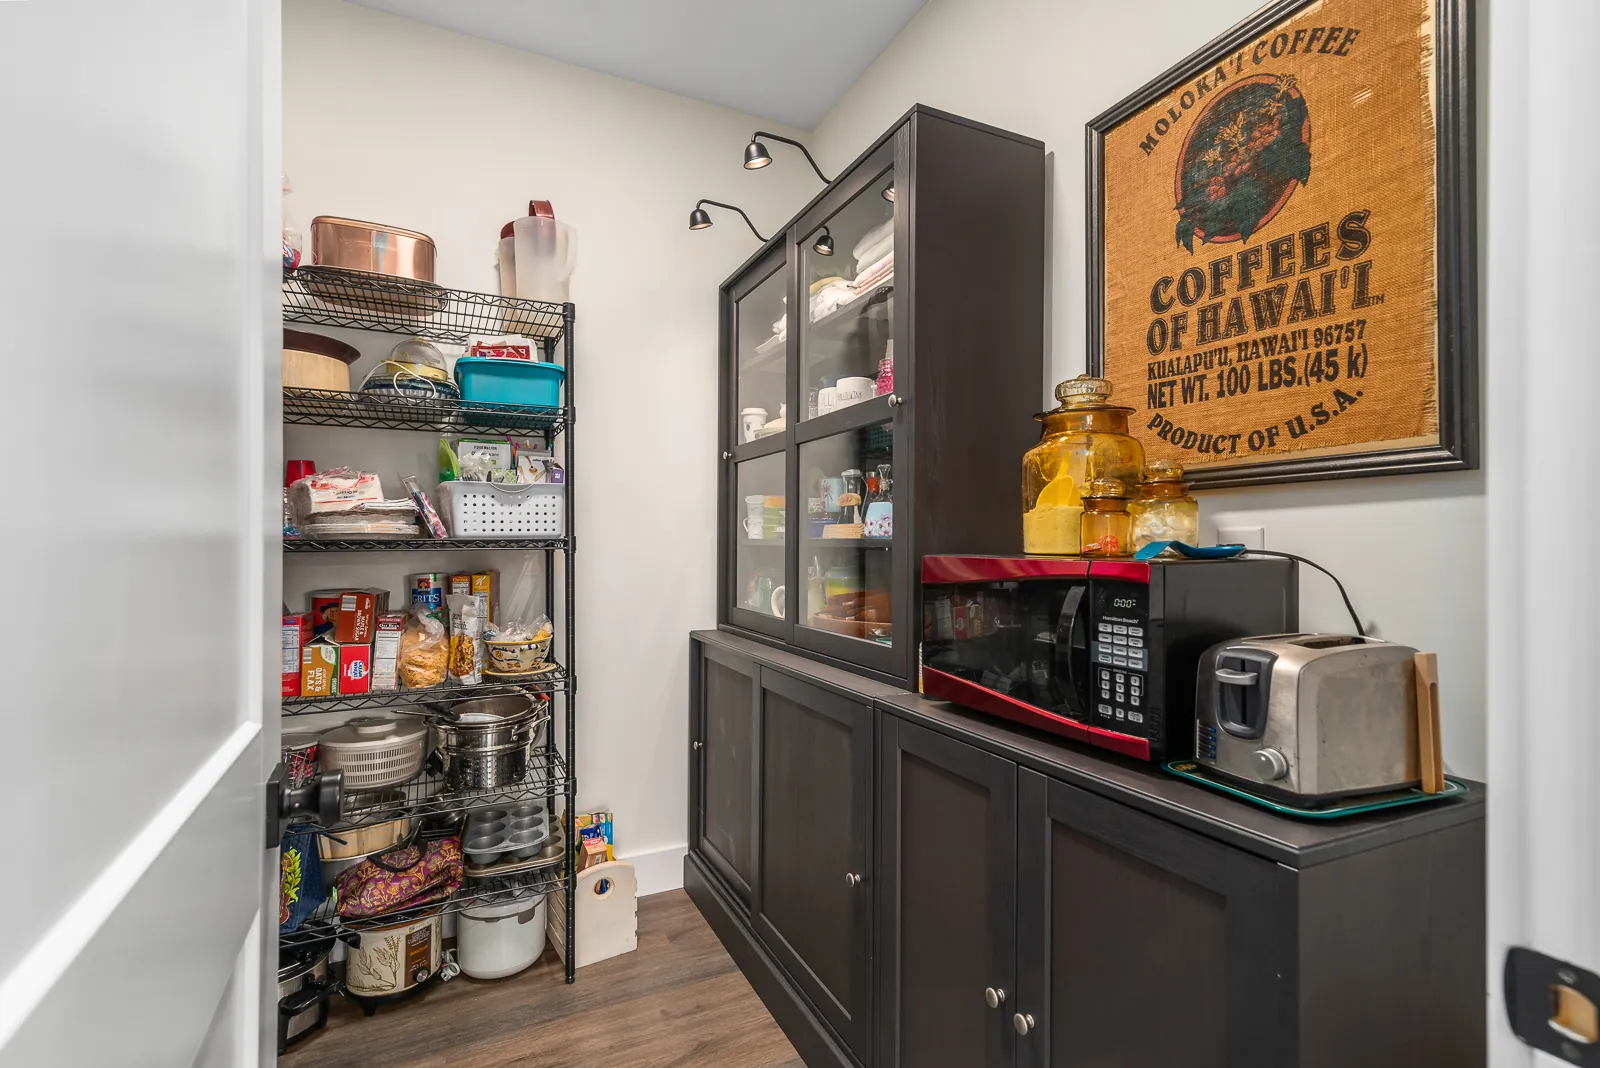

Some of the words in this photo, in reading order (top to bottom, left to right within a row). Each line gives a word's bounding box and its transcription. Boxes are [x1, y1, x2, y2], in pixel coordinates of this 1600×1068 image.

[1139, 52, 1244, 156] MOLOKA'I
[1253, 27, 1360, 65] COFFEE
[1150, 208, 1371, 314] COFFEES
[1146, 311, 1188, 356] OF
[1196, 259, 1372, 346] HAWAI'I
[1236, 328, 1309, 363] HAWAI'I
[1313, 319, 1367, 348] 96757
[1147, 380, 1176, 409] NET
[1181, 373, 1210, 405] WT.
[1216, 364, 1250, 398] 100
[1347, 342, 1368, 379] k)
[1147, 412, 1241, 455] PRODUCT
[1248, 425, 1280, 451] OF
[1284, 388, 1364, 439] U.S.A.
[412, 593, 440, 603] GRITS
[306, 670, 315, 691] FLAX
